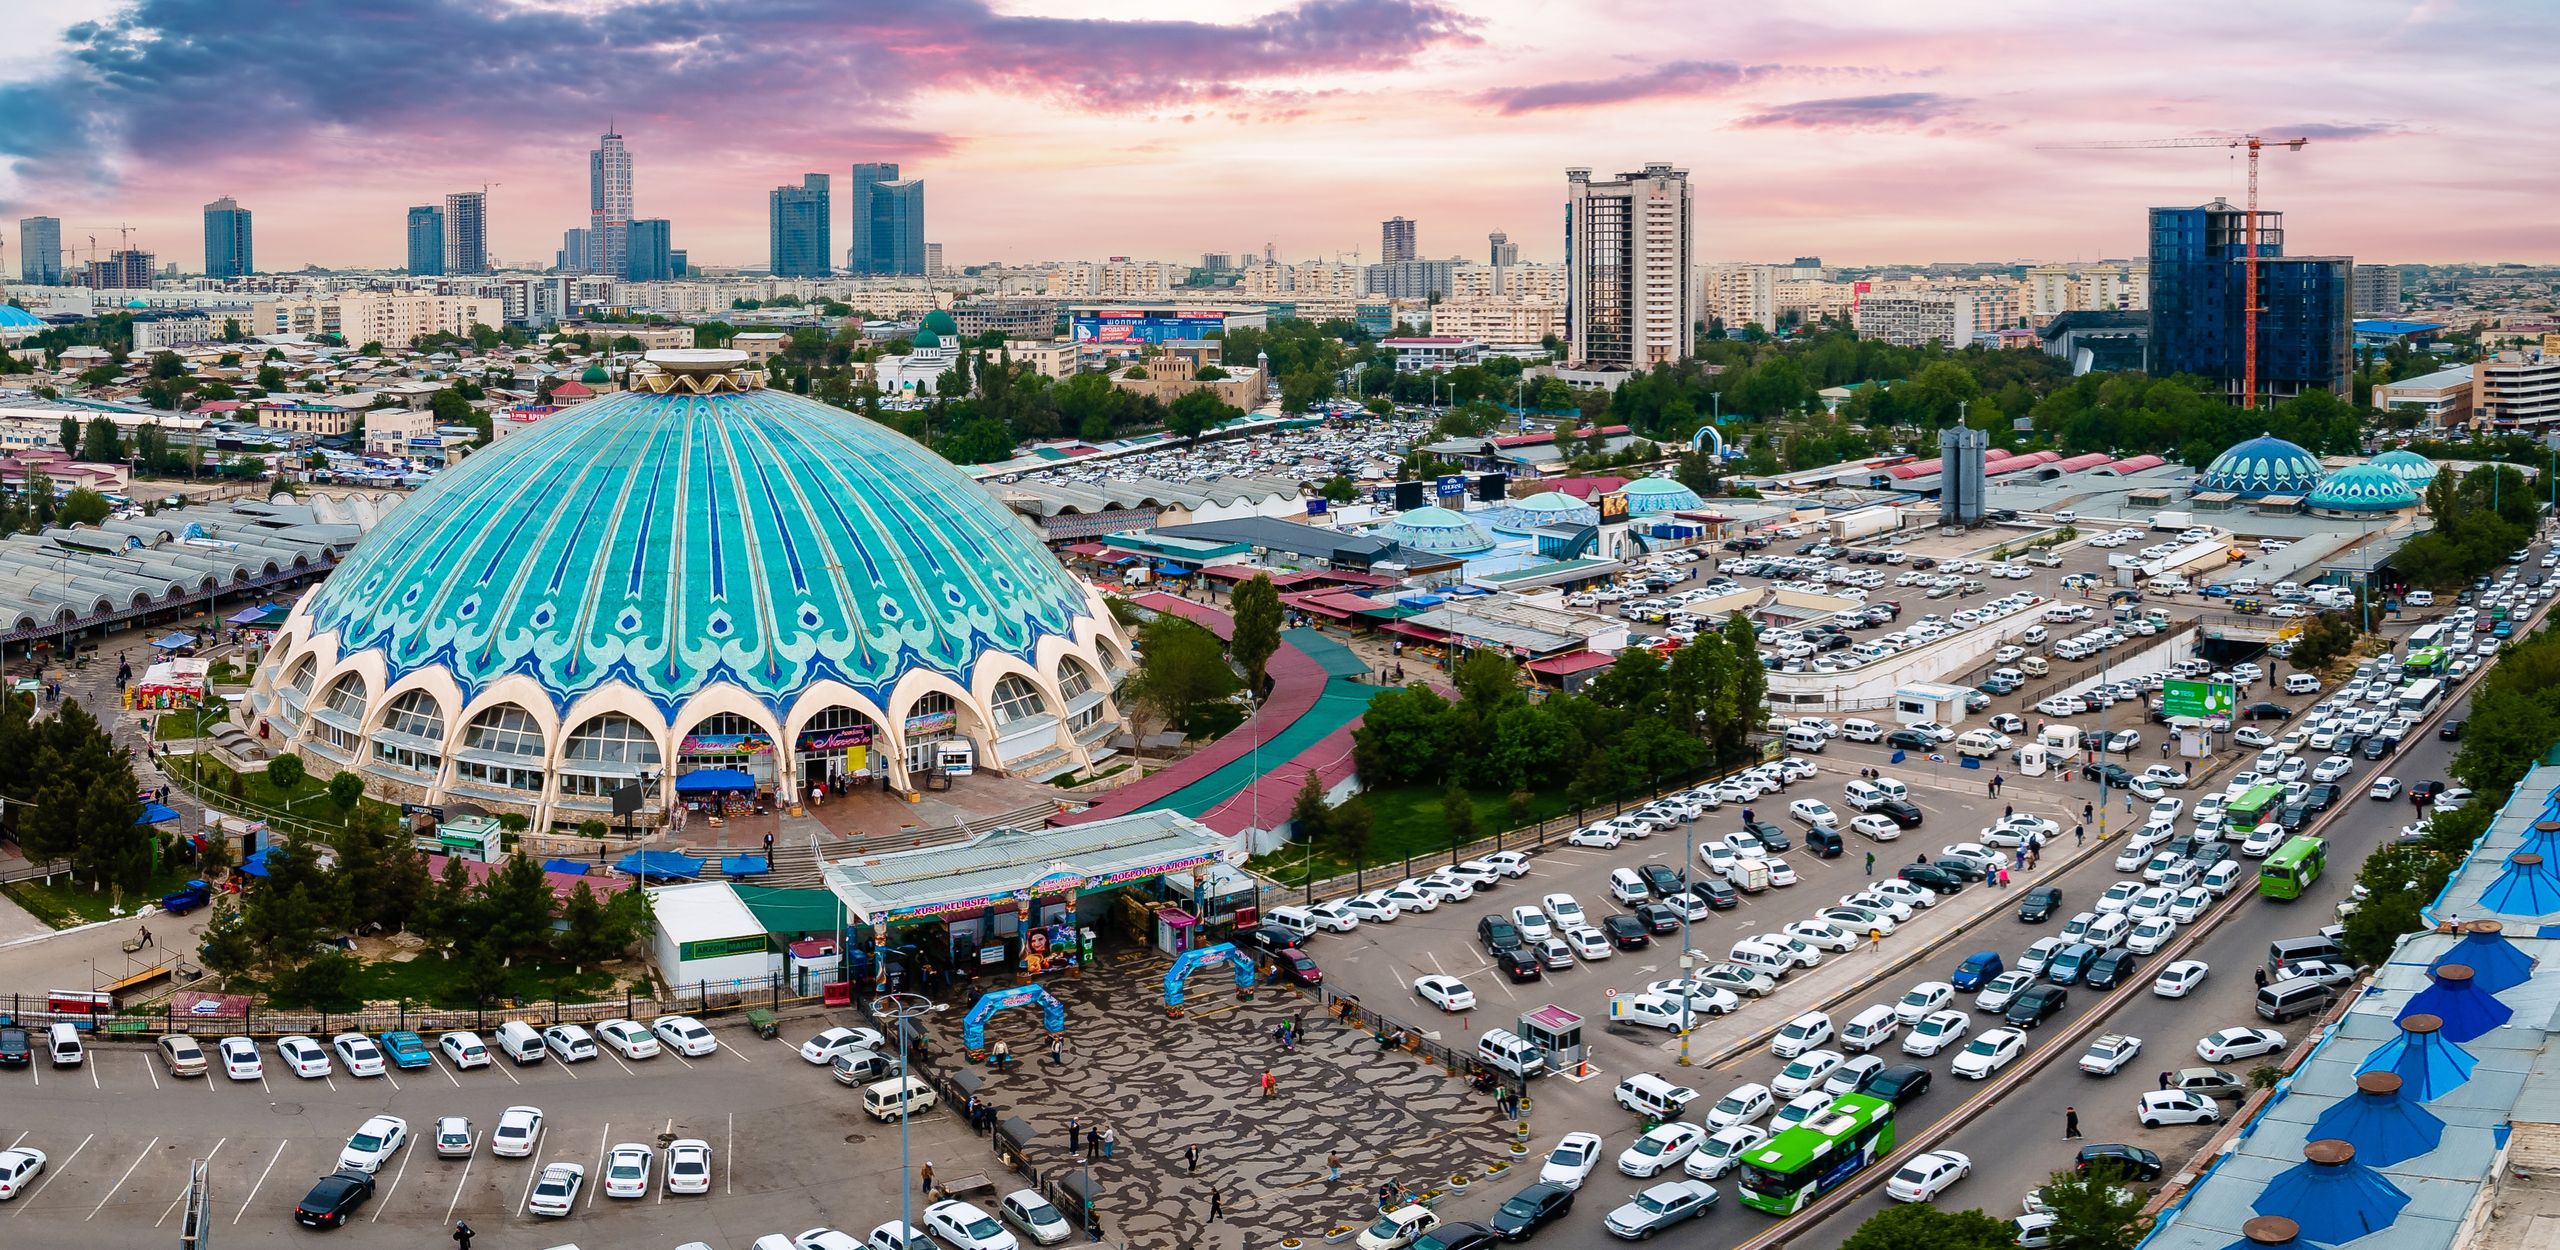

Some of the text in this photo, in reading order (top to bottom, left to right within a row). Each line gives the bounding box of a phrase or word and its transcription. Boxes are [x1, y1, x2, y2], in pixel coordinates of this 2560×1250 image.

[1110, 856, 1206, 884] ДОБРО ПОЖАЛОВАТЬ
[914, 896, 989, 916] XUSH KELIBSIZ!
[696, 939, 763, 954] ARZON MARKET
